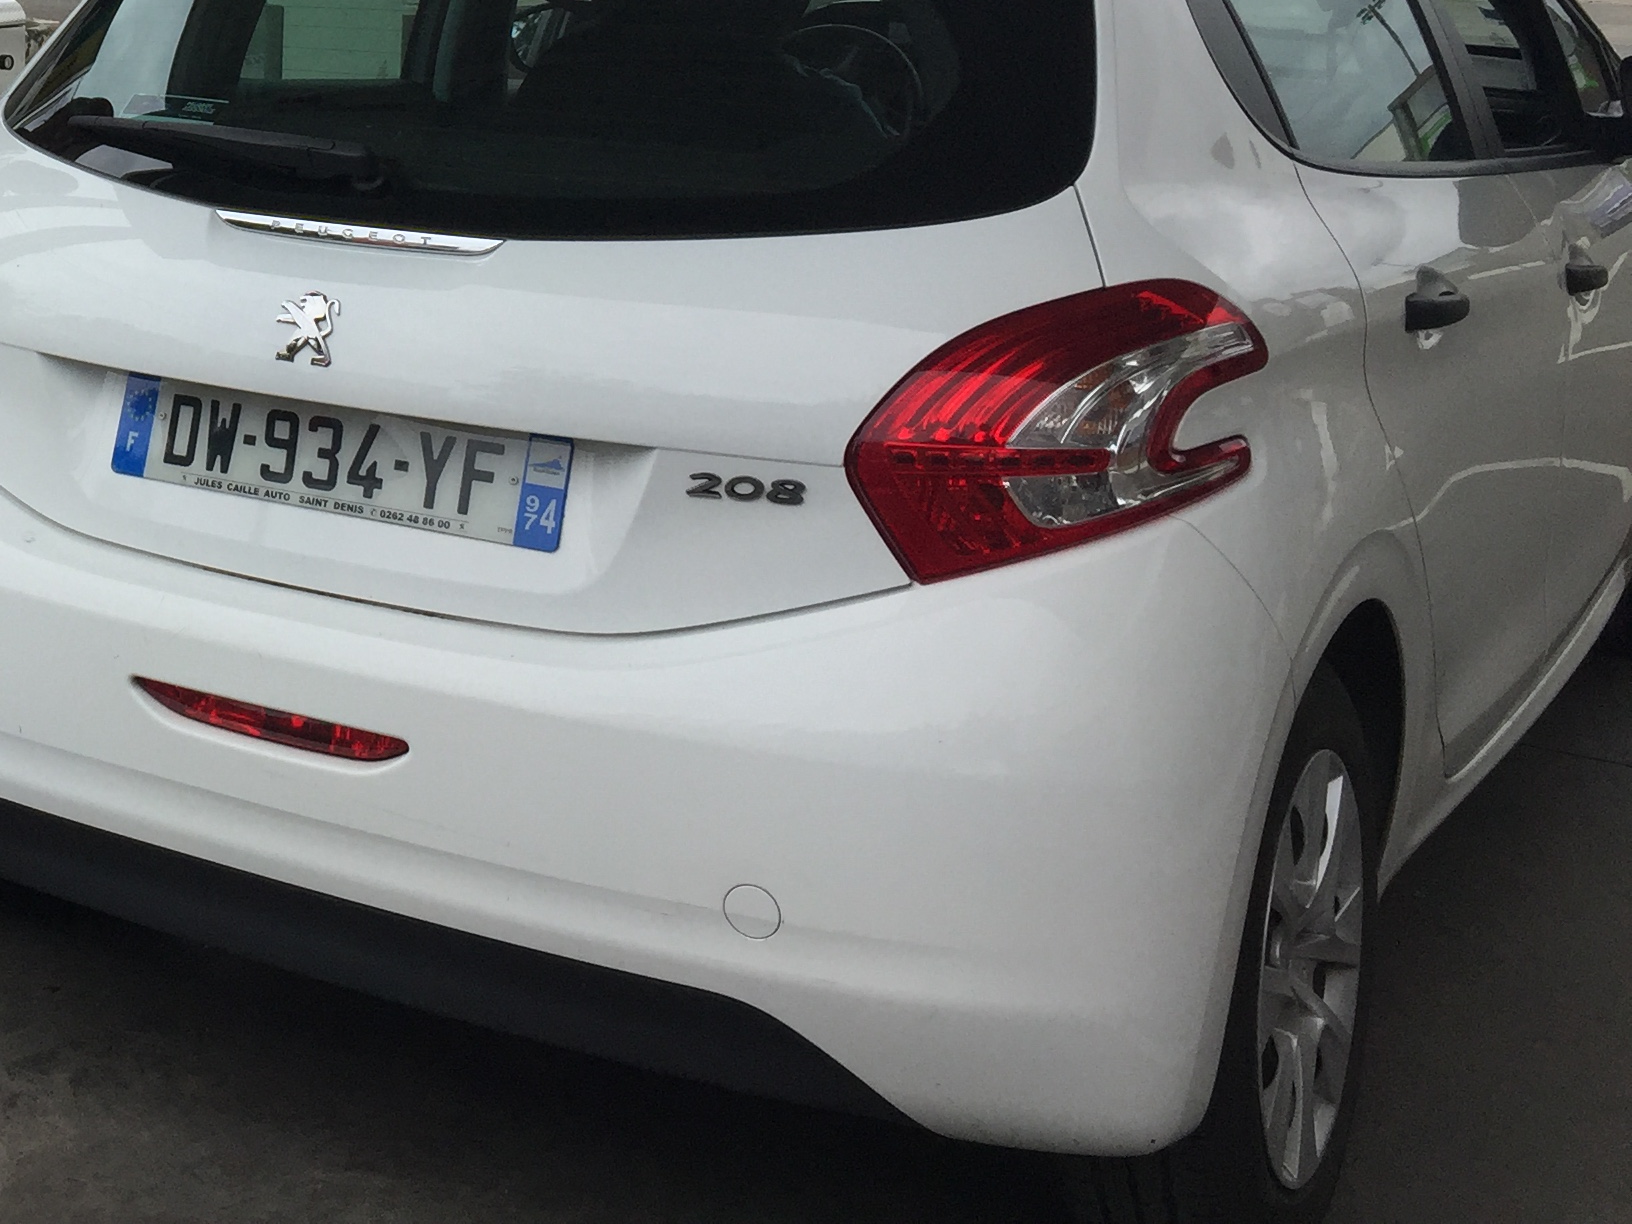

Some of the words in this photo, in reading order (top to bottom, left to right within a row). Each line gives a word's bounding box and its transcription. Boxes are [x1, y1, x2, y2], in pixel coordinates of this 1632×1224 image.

[270, 219, 432, 246] PEUGEOT
[126, 430, 139, 452] F
[162, 392, 506, 516] DW-934-YF
[193, 476, 223, 490] JULES
[226, 482, 260, 496] CAILLE
[263, 489, 291, 502] AUTO
[298, 495, 329, 509] SAINT
[333, 501, 365, 515] DENIS
[379, 508, 405, 522] 0262
[437, 519, 451, 530] 00
[685, 471, 807, 506] 208
